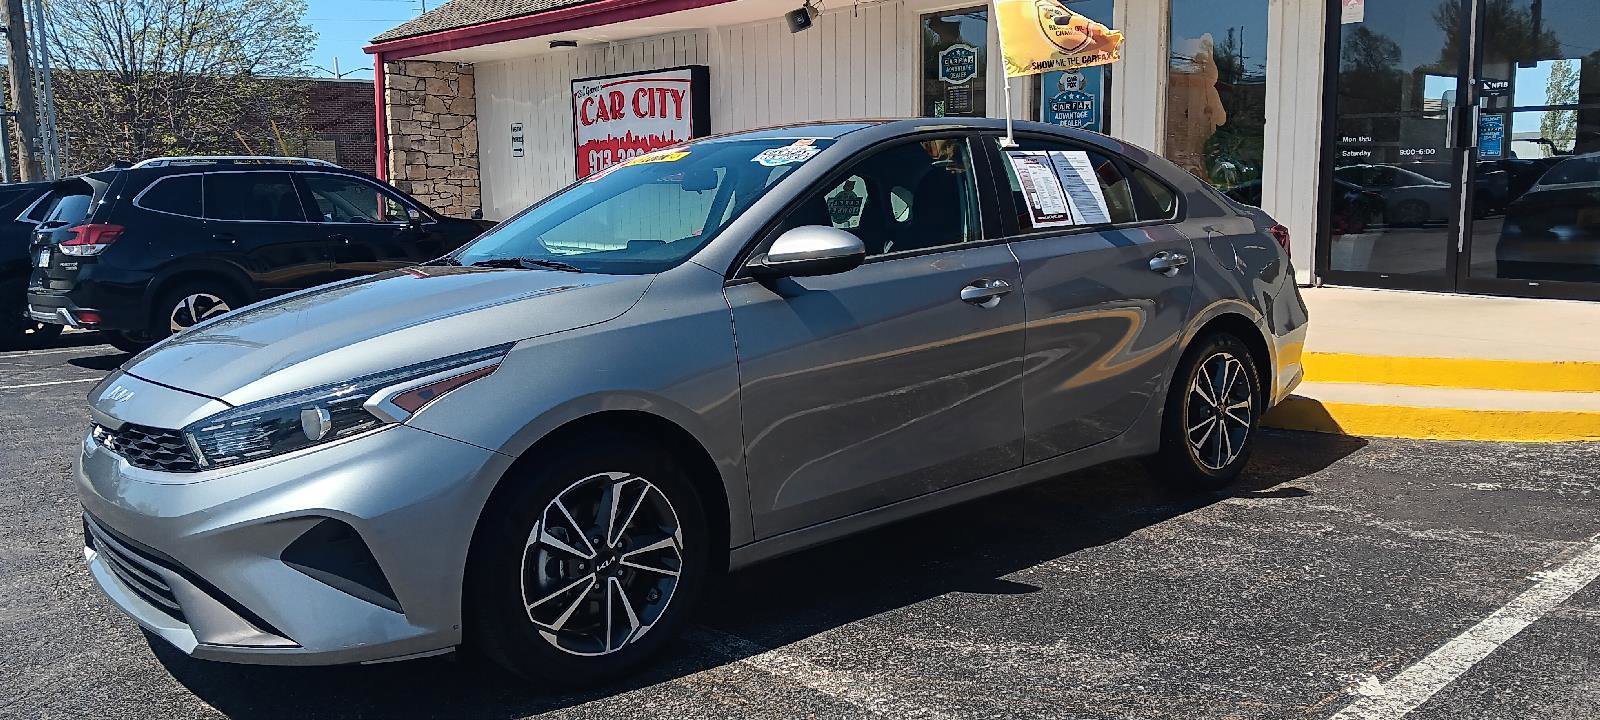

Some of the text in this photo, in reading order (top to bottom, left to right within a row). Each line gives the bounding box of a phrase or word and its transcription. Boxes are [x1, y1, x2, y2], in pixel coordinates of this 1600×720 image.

[944, 56, 974, 65] CARFAX
[1031, 60, 1055, 70] SHOW
[1067, 56, 1080, 65] THE
[1081, 52, 1112, 63] CARFAX
[1491, 81, 1509, 89] NFIB
[581, 87, 686, 126] CAR CITY
[1052, 101, 1092, 111] CARFAX
[1054, 111, 1089, 120] ADVANTAGE
[1060, 119, 1082, 127] DEALER
[596, 555, 616, 572] KIA
